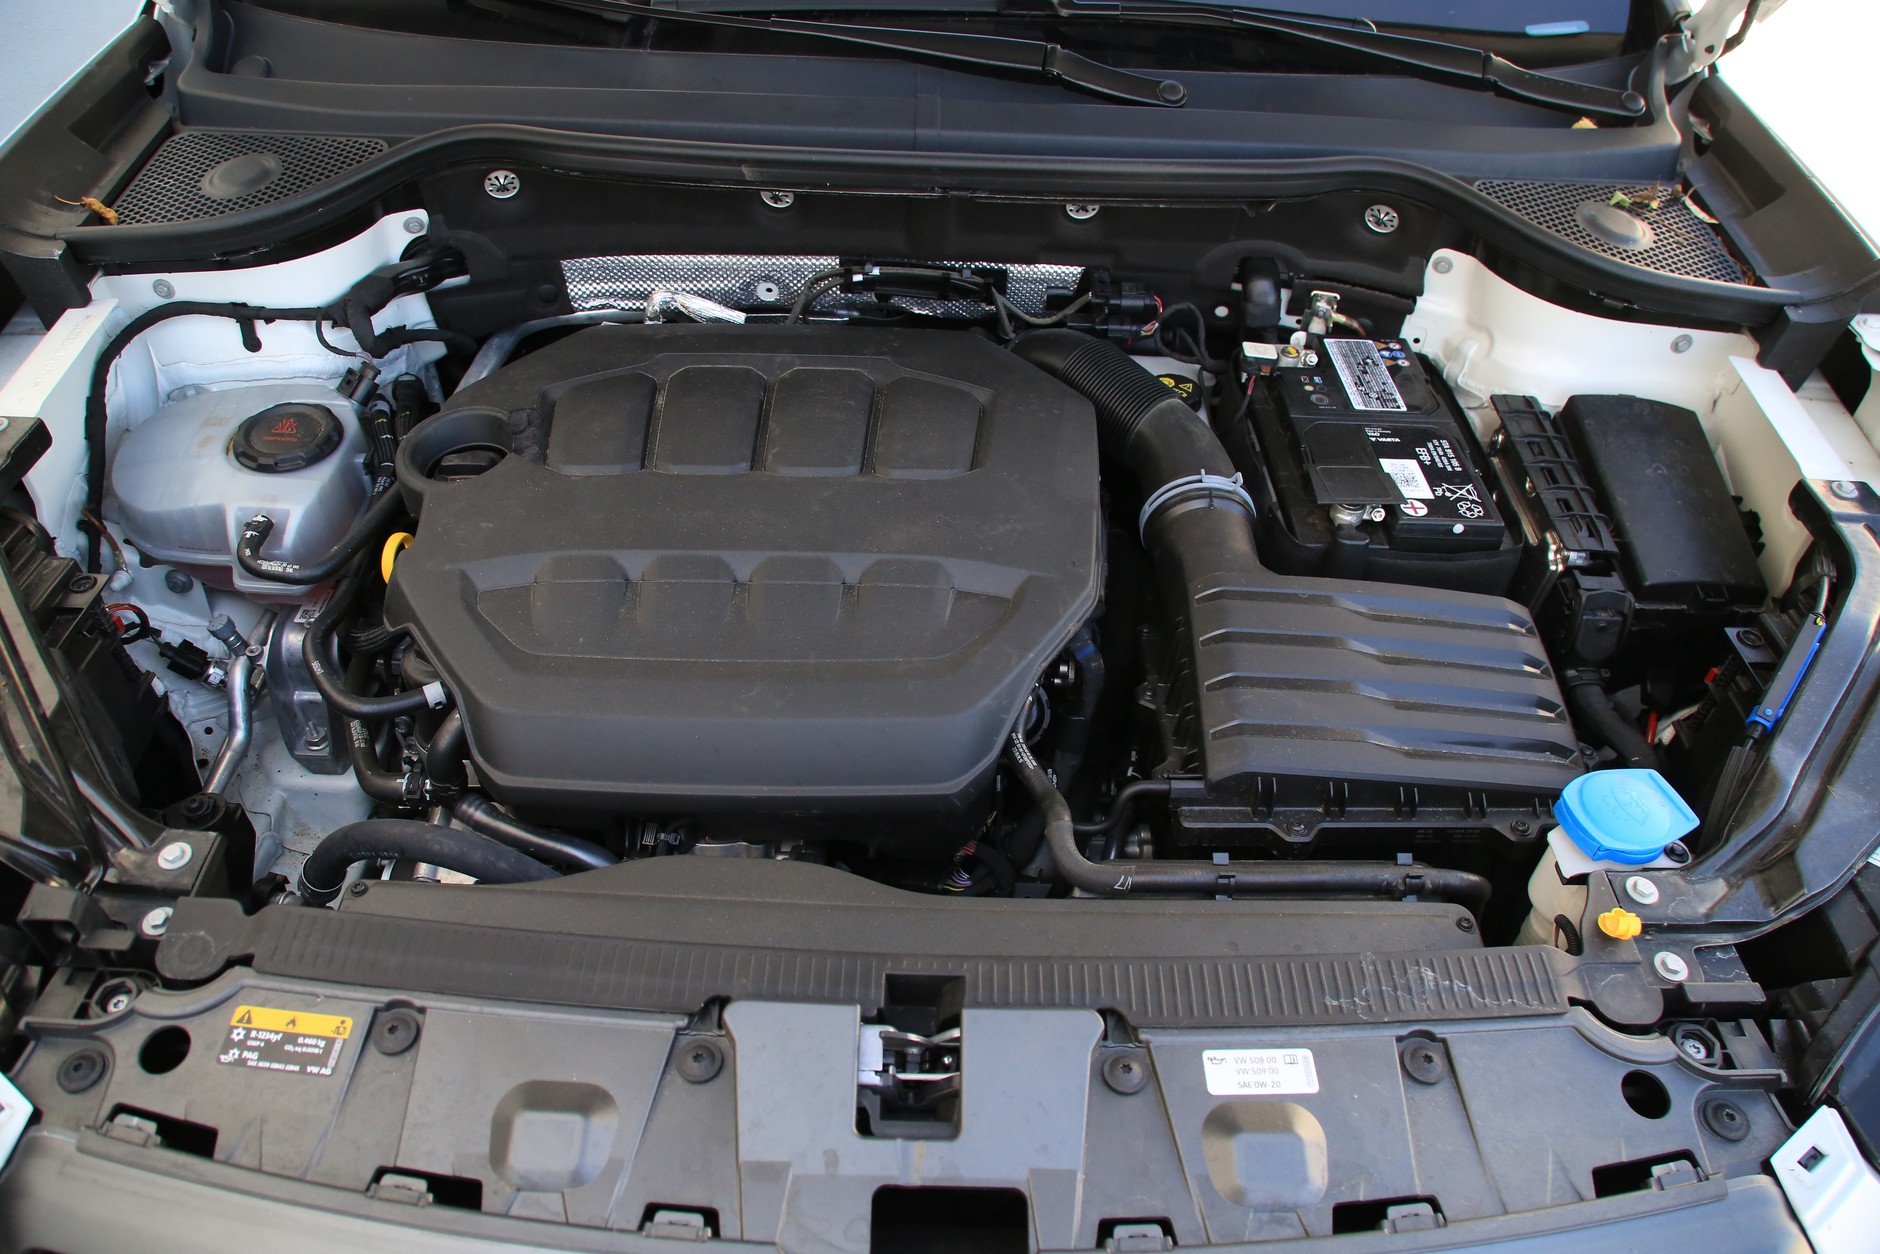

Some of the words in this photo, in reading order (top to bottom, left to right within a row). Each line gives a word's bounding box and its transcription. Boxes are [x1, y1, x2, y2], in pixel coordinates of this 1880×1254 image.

[1415, 448, 1432, 466] EFB+
[1433, 487, 1444, 497] Pb
[250, 1031, 283, 1042] R-1234yf
[318, 1039, 327, 1048] kg
[242, 1051, 259, 1060] PAG
[306, 1066, 320, 1074] VW
[320, 1067, 332, 1076] AG
